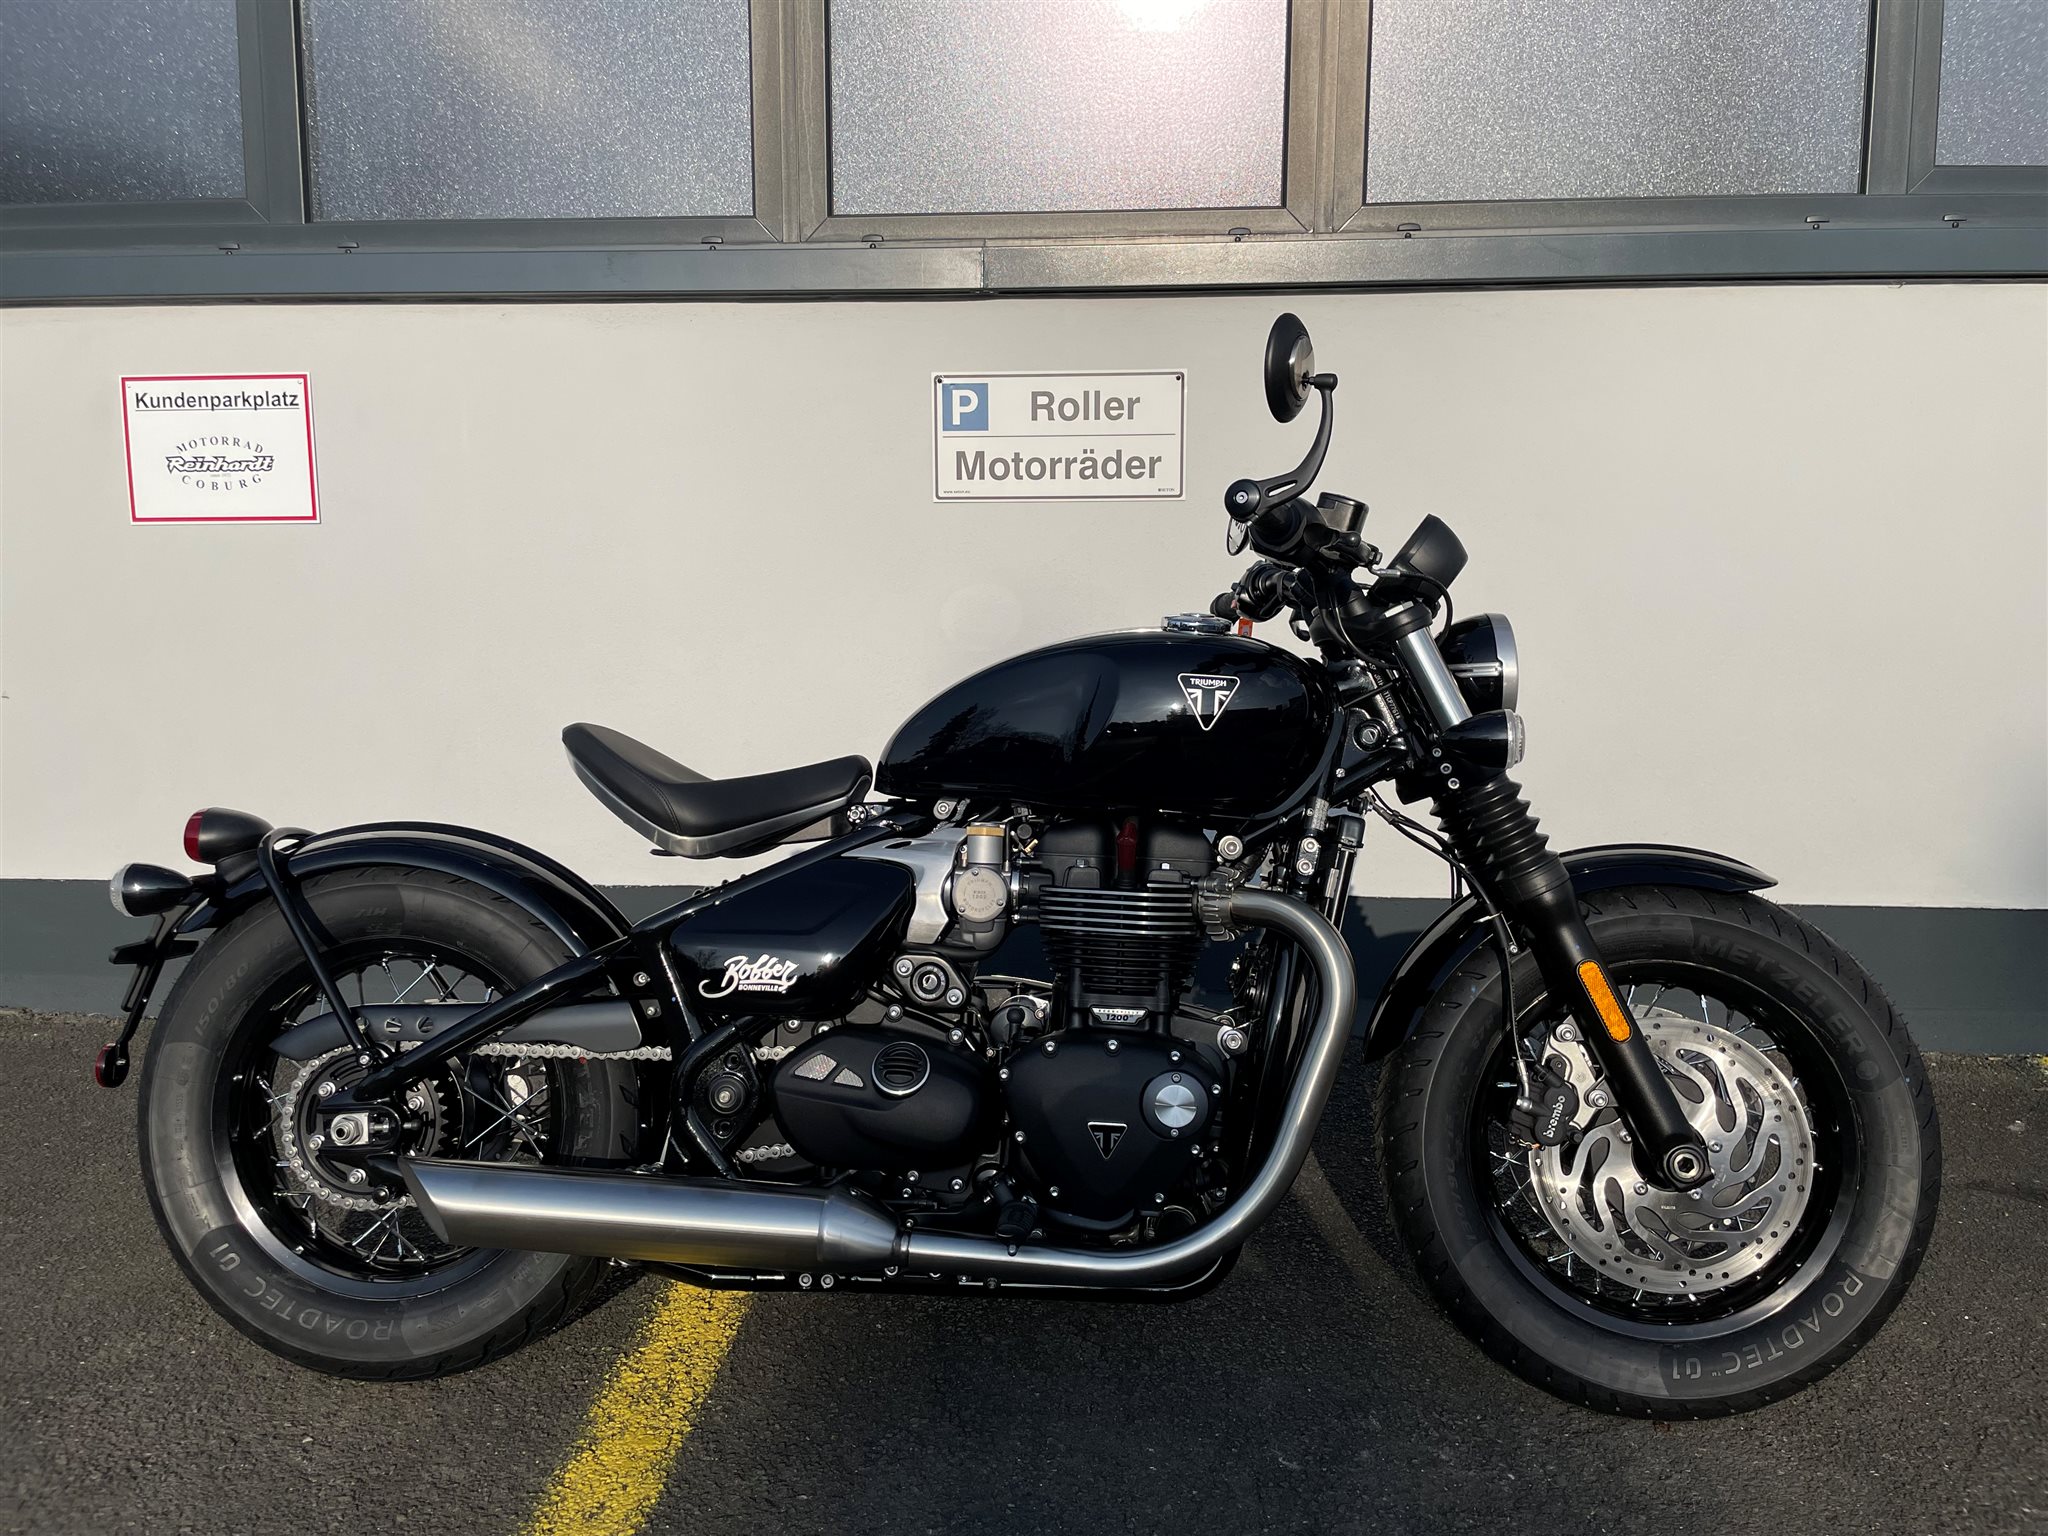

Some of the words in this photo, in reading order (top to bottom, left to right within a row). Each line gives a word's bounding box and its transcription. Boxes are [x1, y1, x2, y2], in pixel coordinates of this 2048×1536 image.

[135, 391, 300, 411] Kundenparkplatz
[951, 389, 979, 426] P
[1031, 390, 1141, 422] Roller
[176, 436, 264, 454] MOTORRAD
[165, 455, 275, 475] Reinhardt
[955, 448, 1162, 481] Motorräder
[181, 474, 262, 491] COBURG
[1189, 677, 1227, 687] TRIUMPH
[698, 953, 800, 999] Bobber
[738, 984, 779, 992] BONNEVILLE
[1543, 1095, 1566, 1138] brembo
[243, 1276, 395, 1341] ROADTEC
[1721, 1269, 1864, 1375] ROADTEC
[1672, 1357, 1701, 1380] 01
